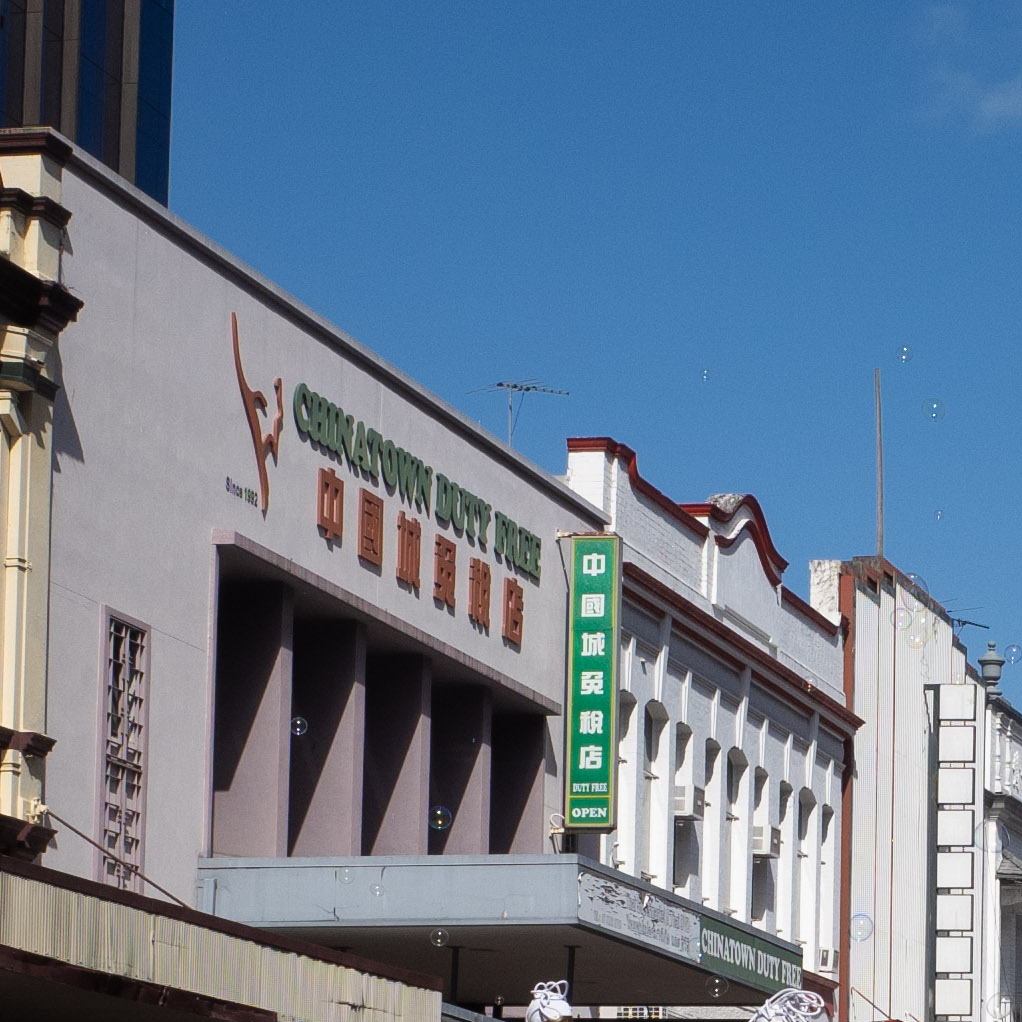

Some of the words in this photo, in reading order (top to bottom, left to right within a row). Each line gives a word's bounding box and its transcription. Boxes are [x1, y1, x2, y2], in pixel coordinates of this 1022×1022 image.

[226, 476, 243, 499] Since
[293, 383, 433, 512] CHINATOWN
[435, 472, 492, 546] DUTY
[494, 511, 541, 579] FREE
[572, 783, 590, 793] DUTY
[591, 783, 608, 793] FREE
[571, 807, 608, 818] OPEN
[701, 927, 756, 972] CHINATOWN
[757, 949, 781, 982] DUTY
[781, 959, 802, 990] FREE
